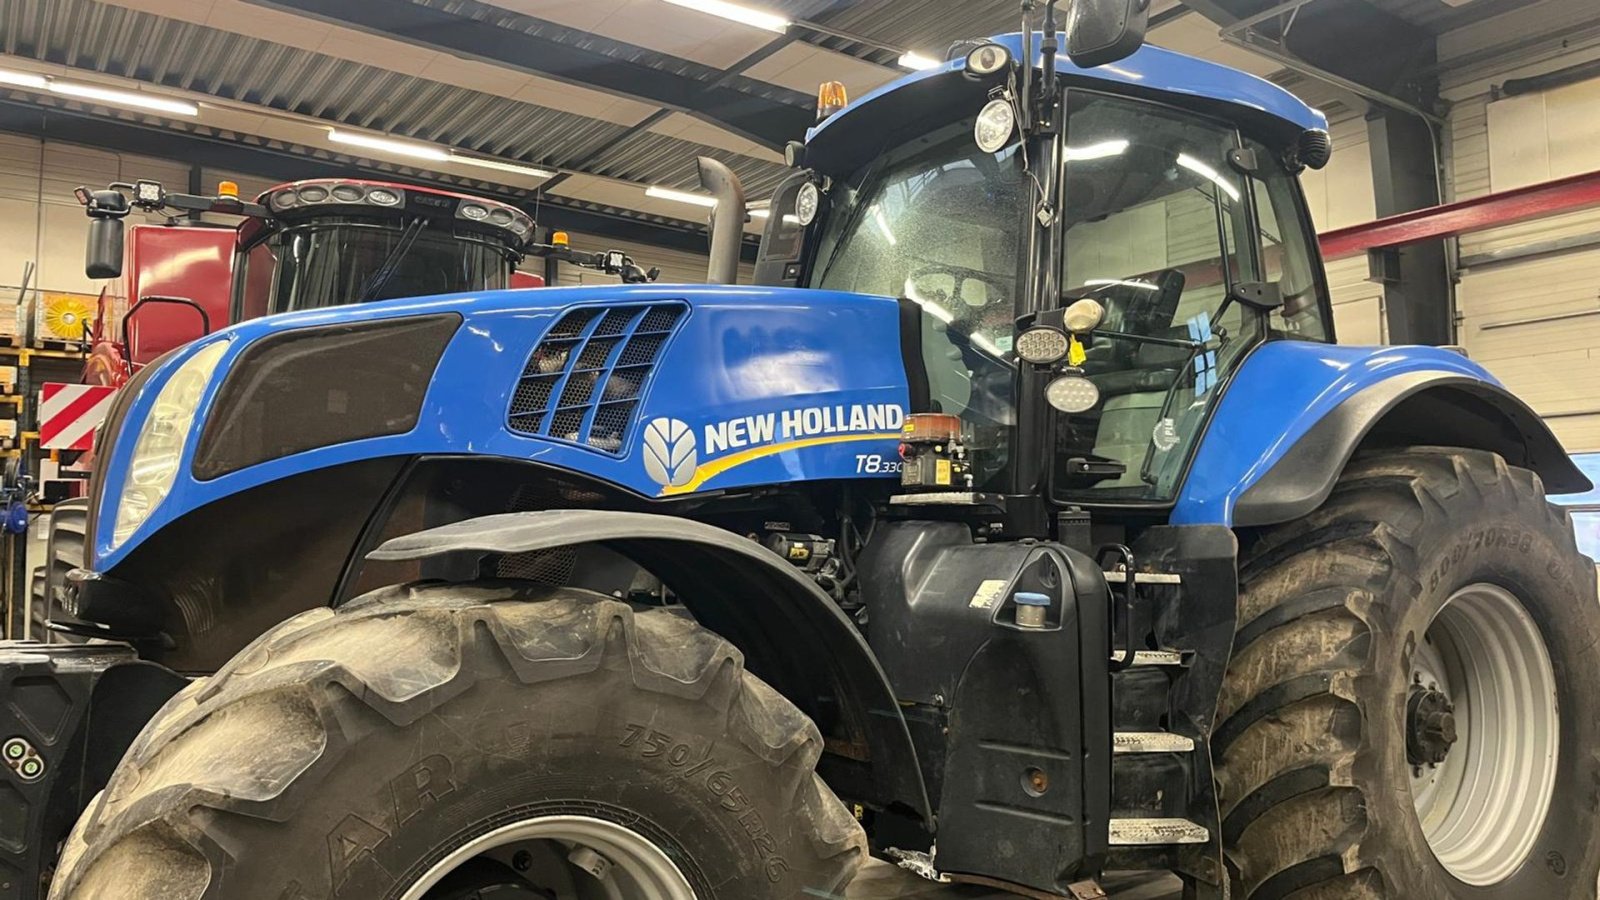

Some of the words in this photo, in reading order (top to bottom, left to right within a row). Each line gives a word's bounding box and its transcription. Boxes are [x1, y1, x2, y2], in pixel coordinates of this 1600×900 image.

[704, 412, 775, 454] NEW
[781, 403, 904, 438] HOLLAND
[281, 753, 458, 900] AR
[618, 723, 791, 884] 750/65R26
